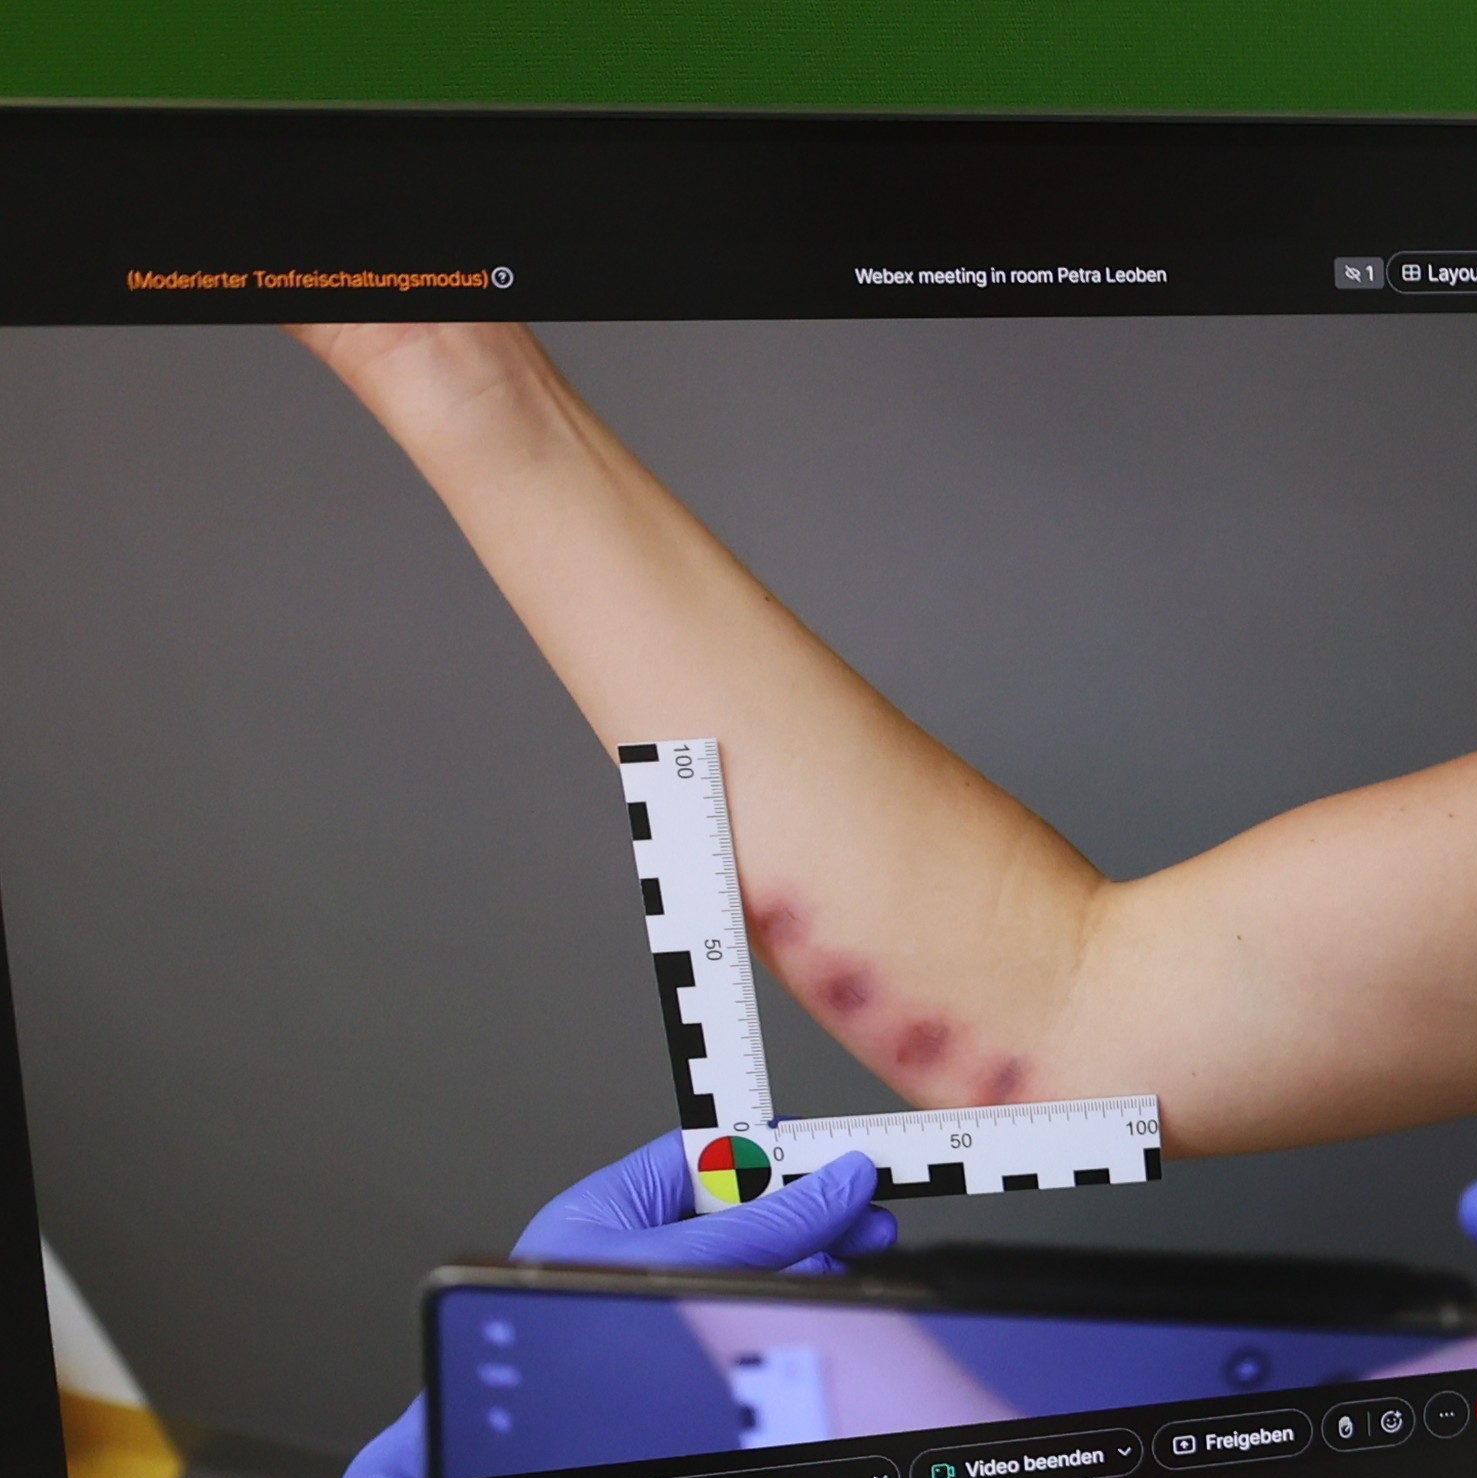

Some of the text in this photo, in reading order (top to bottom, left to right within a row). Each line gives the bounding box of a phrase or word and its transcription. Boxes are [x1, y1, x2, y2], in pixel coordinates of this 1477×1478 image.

[854, 266, 1168, 288] Webex meeting in room Petra Leoben
[673, 744, 695, 780] 100
[704, 938, 723, 962] 50
[949, 1132, 974, 1150] 50
[1125, 1119, 1159, 1137] 100
[1205, 1428, 1295, 1451] Freigeben
[964, 1449, 1105, 1478] Video beenden
